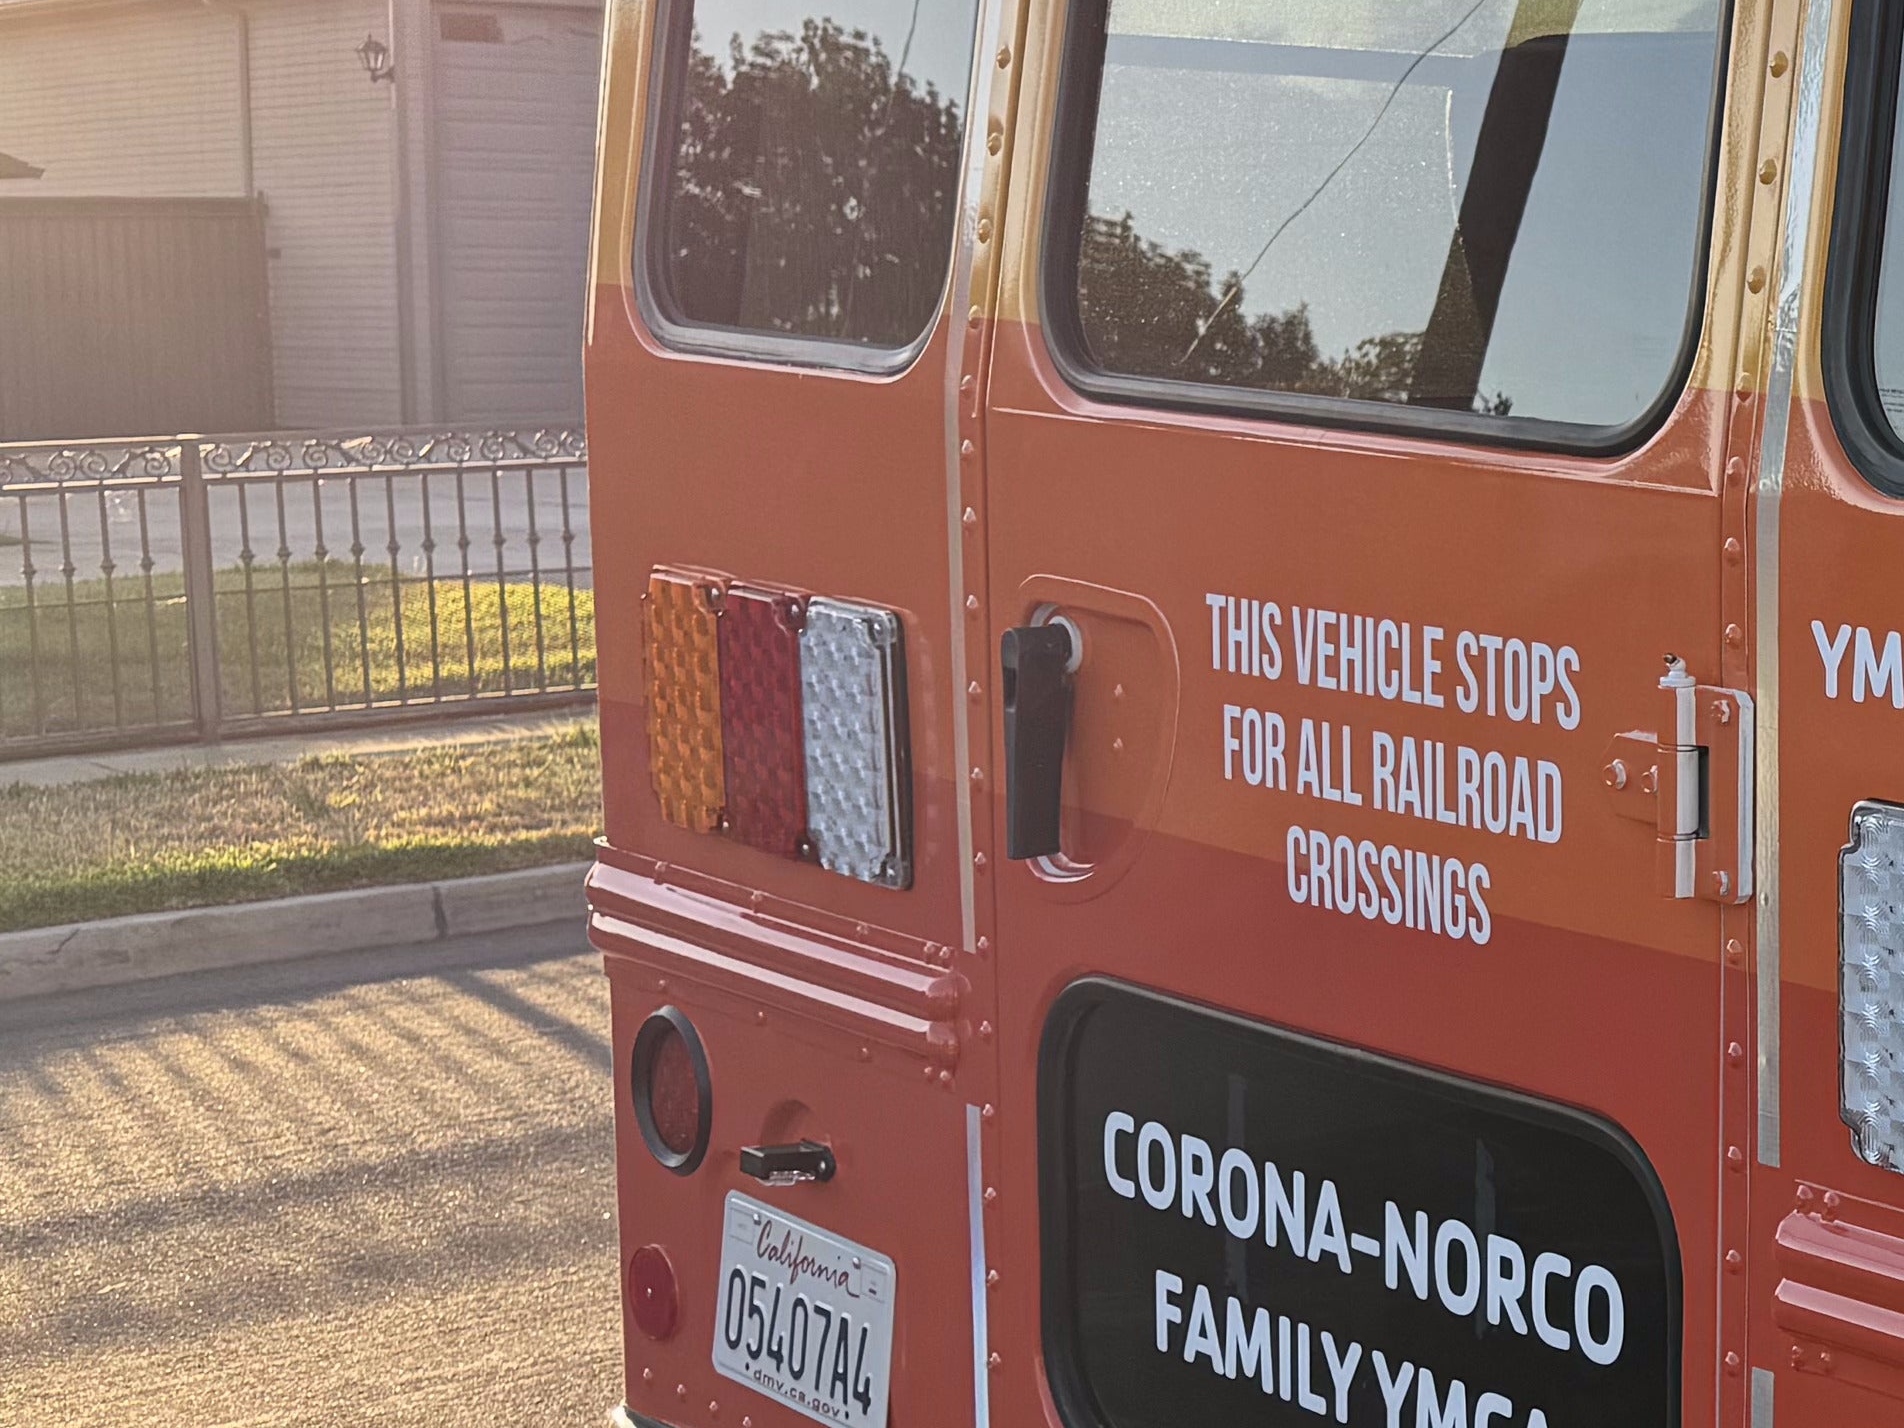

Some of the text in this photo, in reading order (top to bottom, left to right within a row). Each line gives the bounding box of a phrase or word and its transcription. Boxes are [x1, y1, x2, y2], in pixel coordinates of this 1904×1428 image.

[1205, 592, 1580, 731] THIS VEHICLE STOPS
[1223, 704, 1562, 844] FOR ALL RAILROAD
[1286, 825, 1491, 945] CROSSINGS
[756, 1220, 860, 1298] California
[1103, 1110, 1625, 1365] CORONA-NORCO
[724, 1265, 871, 1416] 05407A4
[752, 1368, 840, 1417] dmv.ca.gov
[1155, 1269, 1363, 1424] FAMILY
